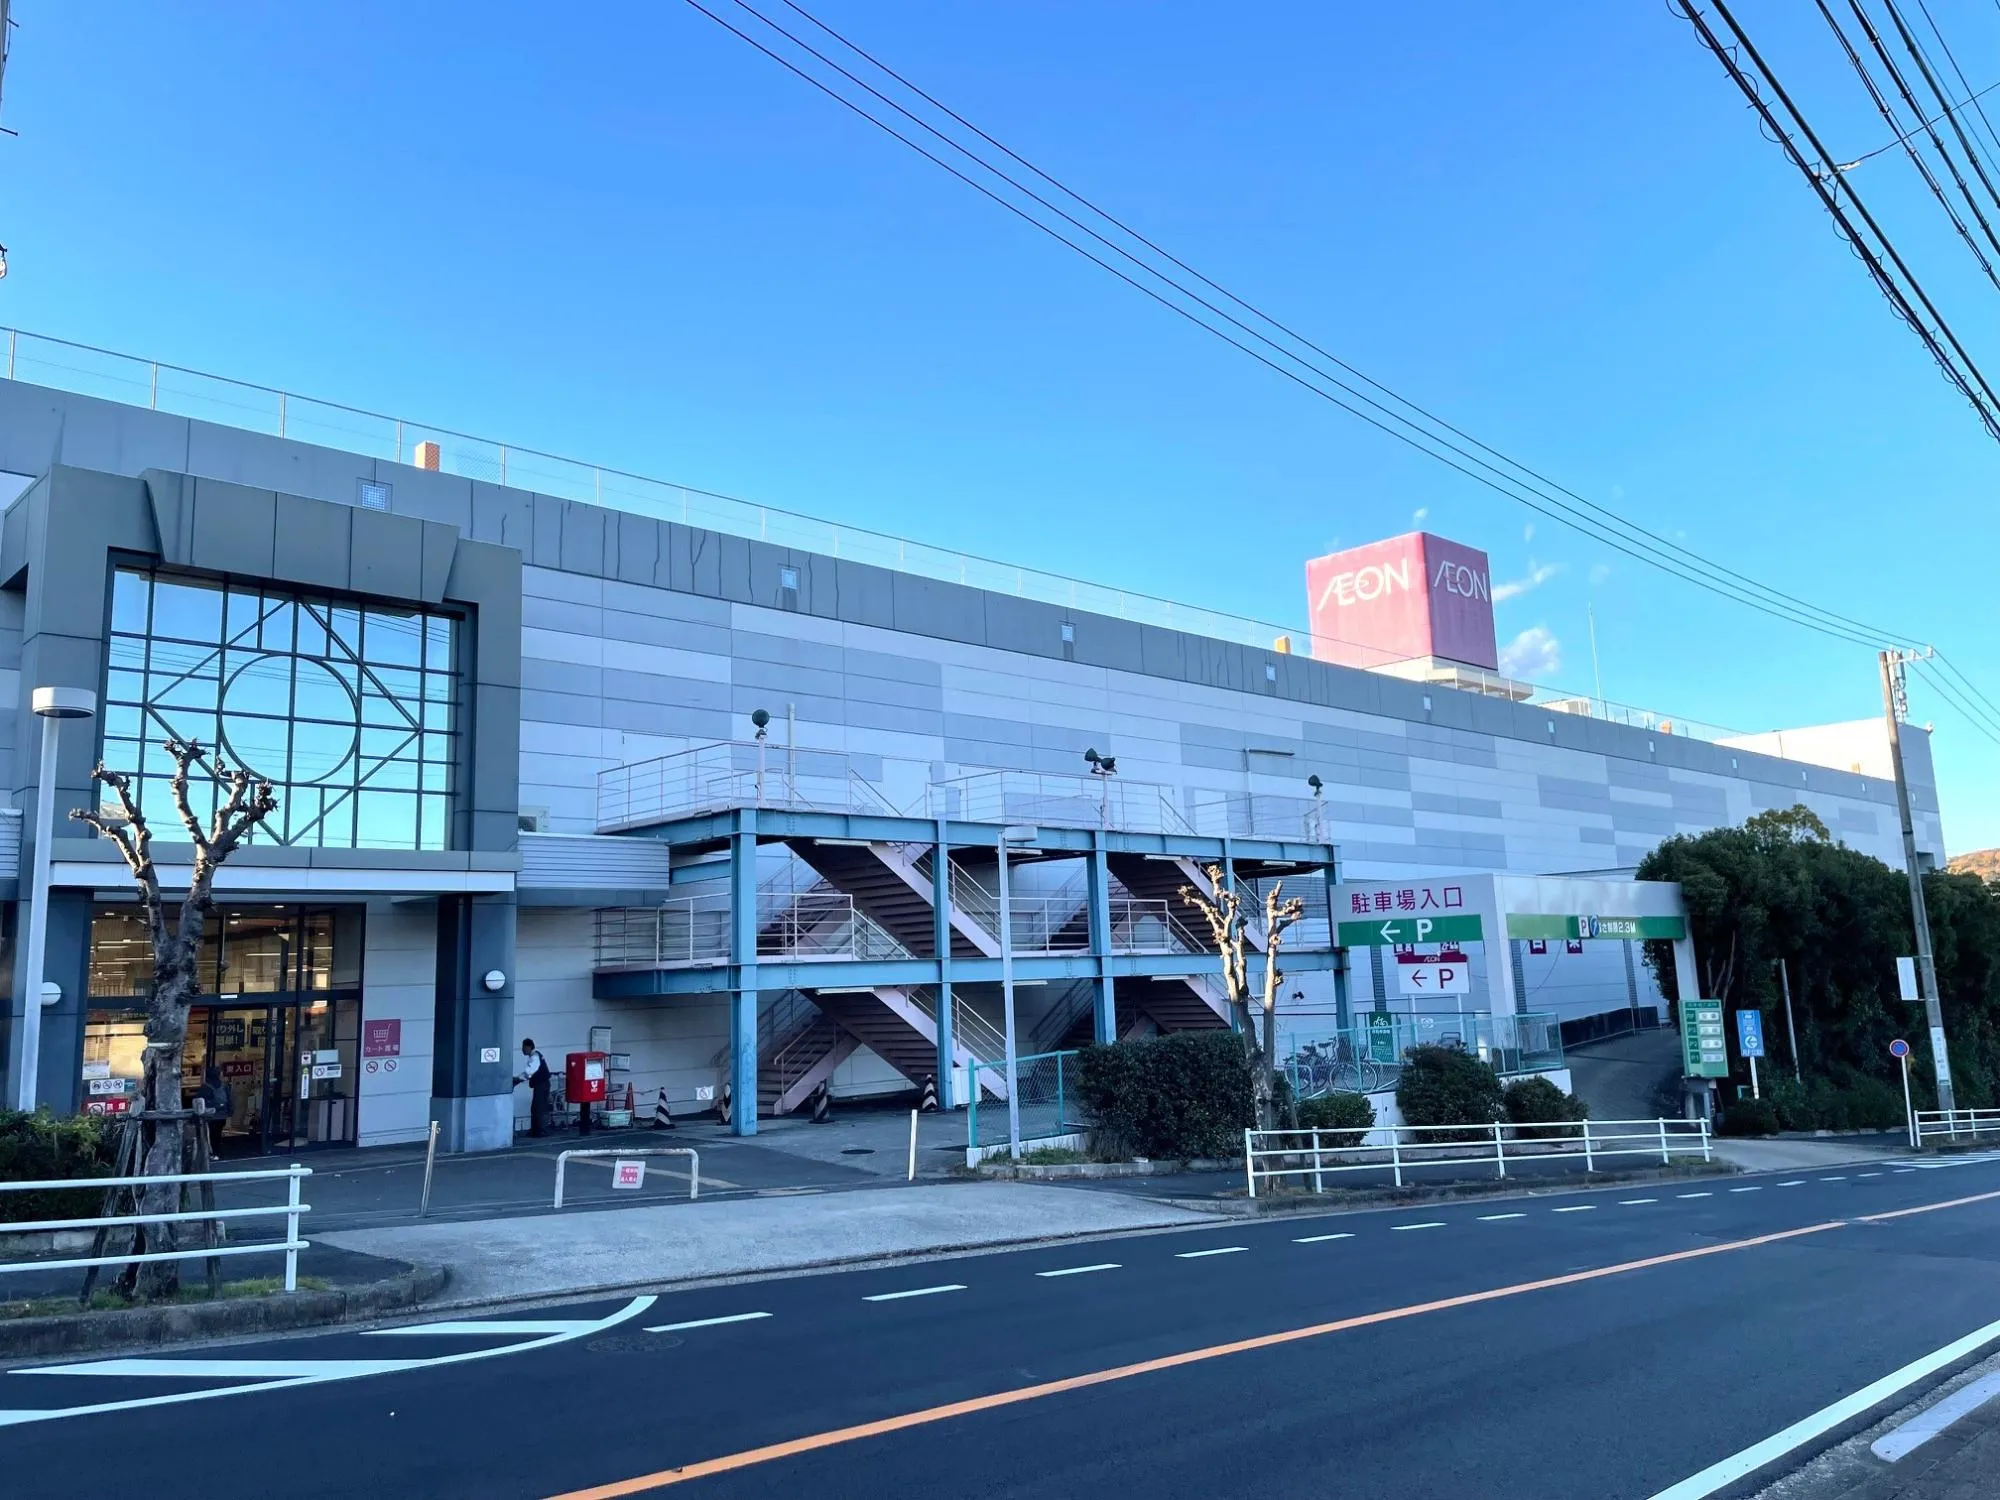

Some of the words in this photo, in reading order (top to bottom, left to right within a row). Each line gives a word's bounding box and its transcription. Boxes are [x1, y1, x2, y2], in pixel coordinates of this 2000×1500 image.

[1351, 886, 1463, 914] 駐車場入口
[1416, 918, 1433, 942] P
[1439, 968, 1454, 989] P
